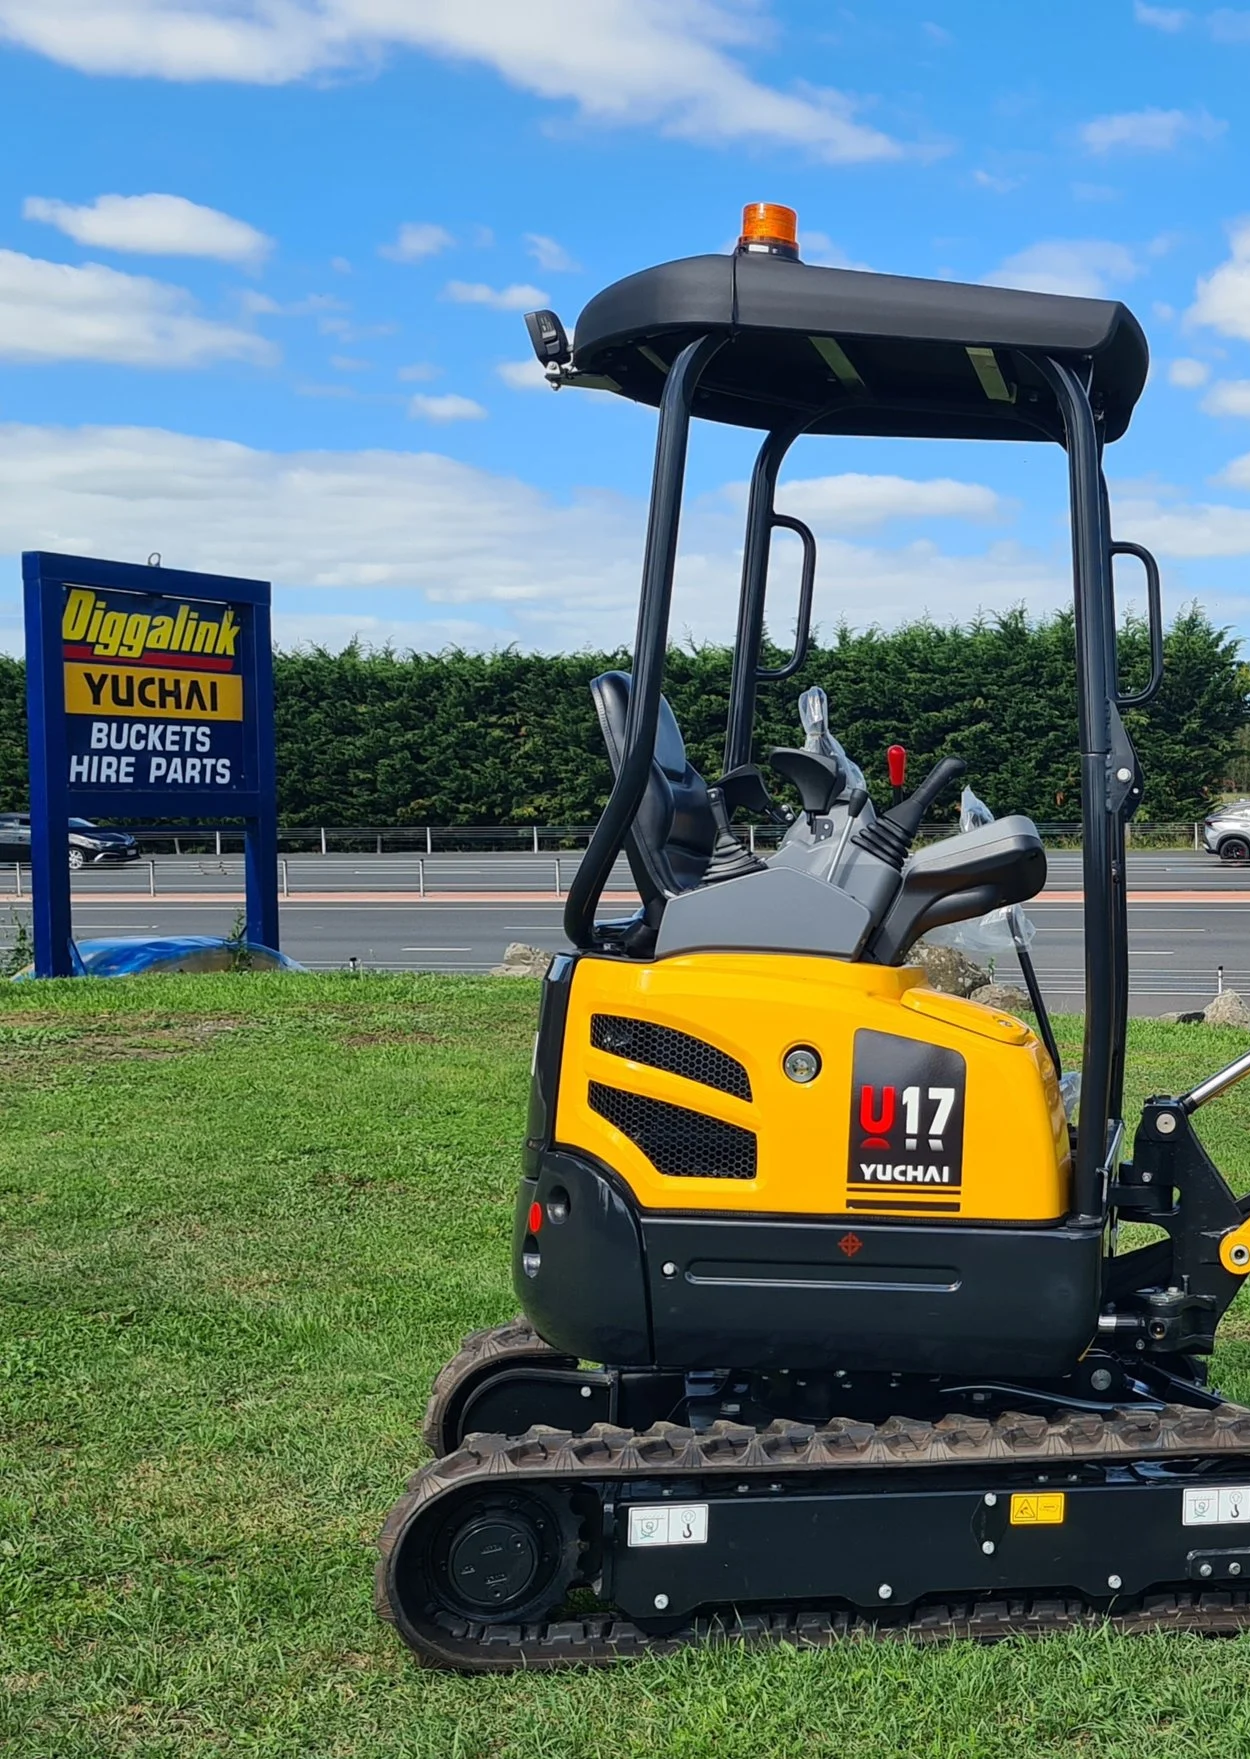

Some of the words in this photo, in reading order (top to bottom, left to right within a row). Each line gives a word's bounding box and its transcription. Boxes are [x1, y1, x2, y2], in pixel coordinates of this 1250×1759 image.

[62, 589, 241, 658] Diggalink
[83, 672, 218, 711] YUCHAI
[90, 722, 211, 752] BUCKETS
[69, 755, 136, 783] HIRE
[149, 757, 231, 784] PARTS
[860, 1085, 955, 1135] U17
[860, 1163, 949, 1183] YUCHAI
